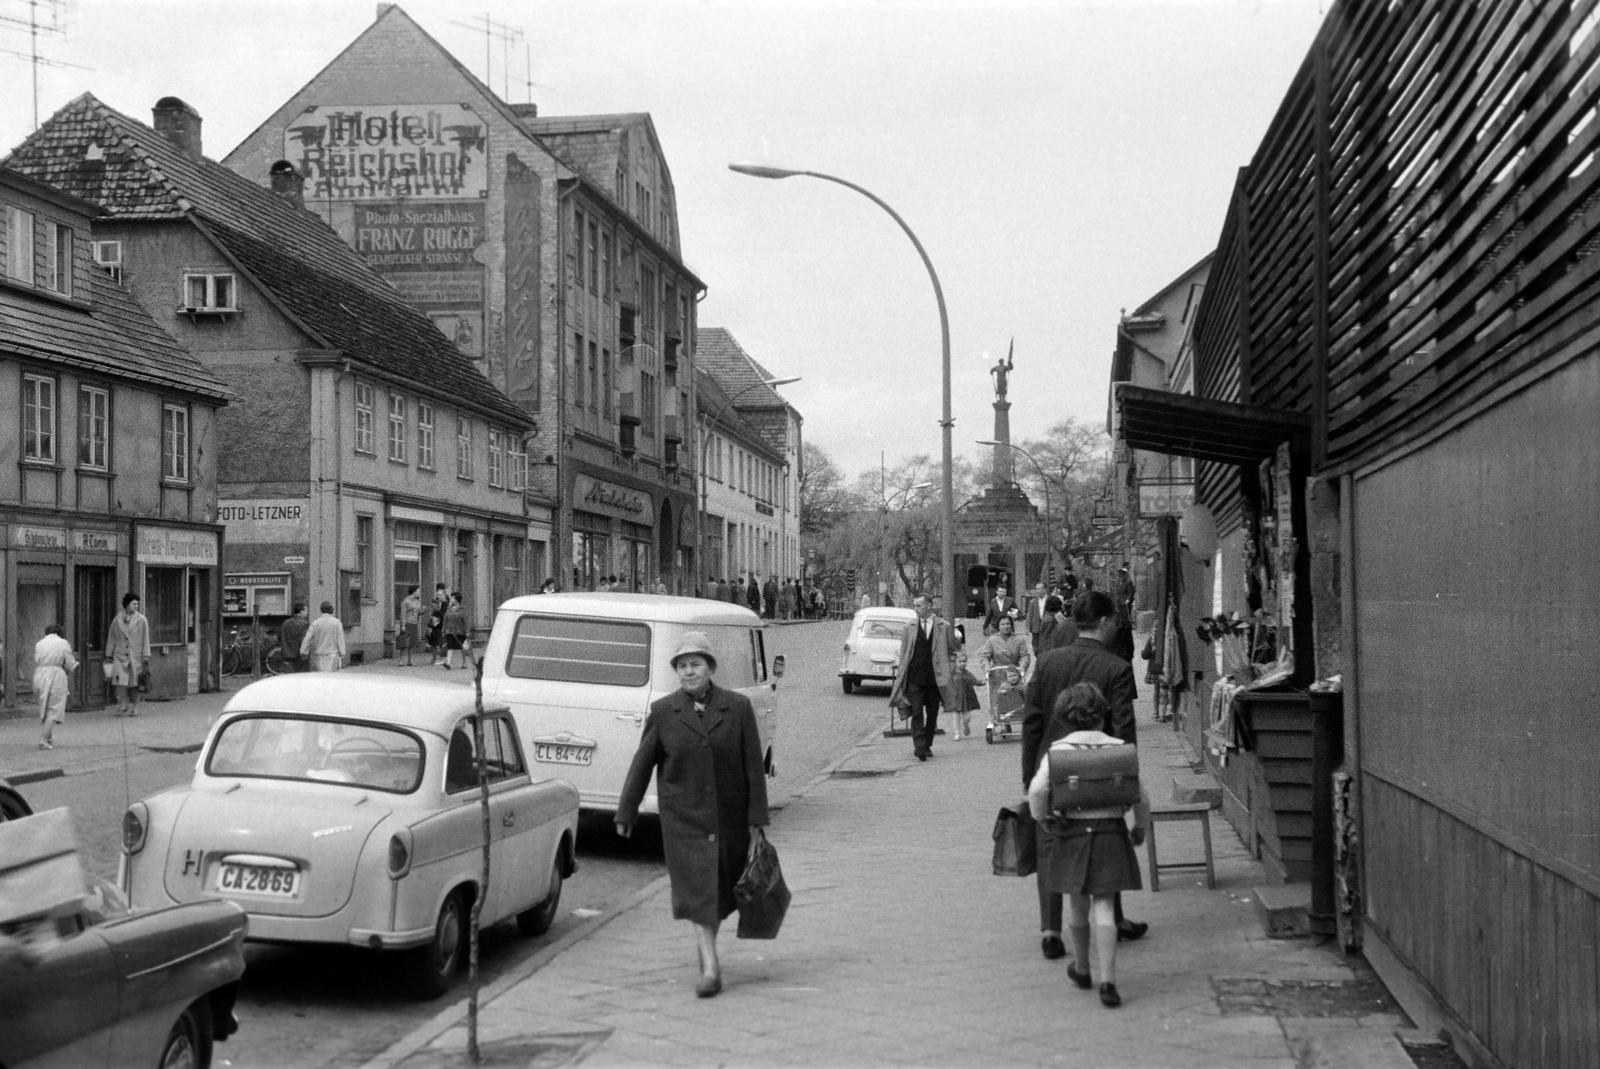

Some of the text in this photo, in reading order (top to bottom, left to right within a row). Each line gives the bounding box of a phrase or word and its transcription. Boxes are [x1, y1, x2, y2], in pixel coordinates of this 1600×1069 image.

[325, 110, 446, 147] Hotel
[299, 148, 472, 178] Reichshof
[358, 226, 479, 250] FRANZ ROGGE
[425, 253, 464, 265] STRASSE
[216, 505, 302, 521] FOTO-LETZNER
[536, 745, 589, 762] CL 84-44
